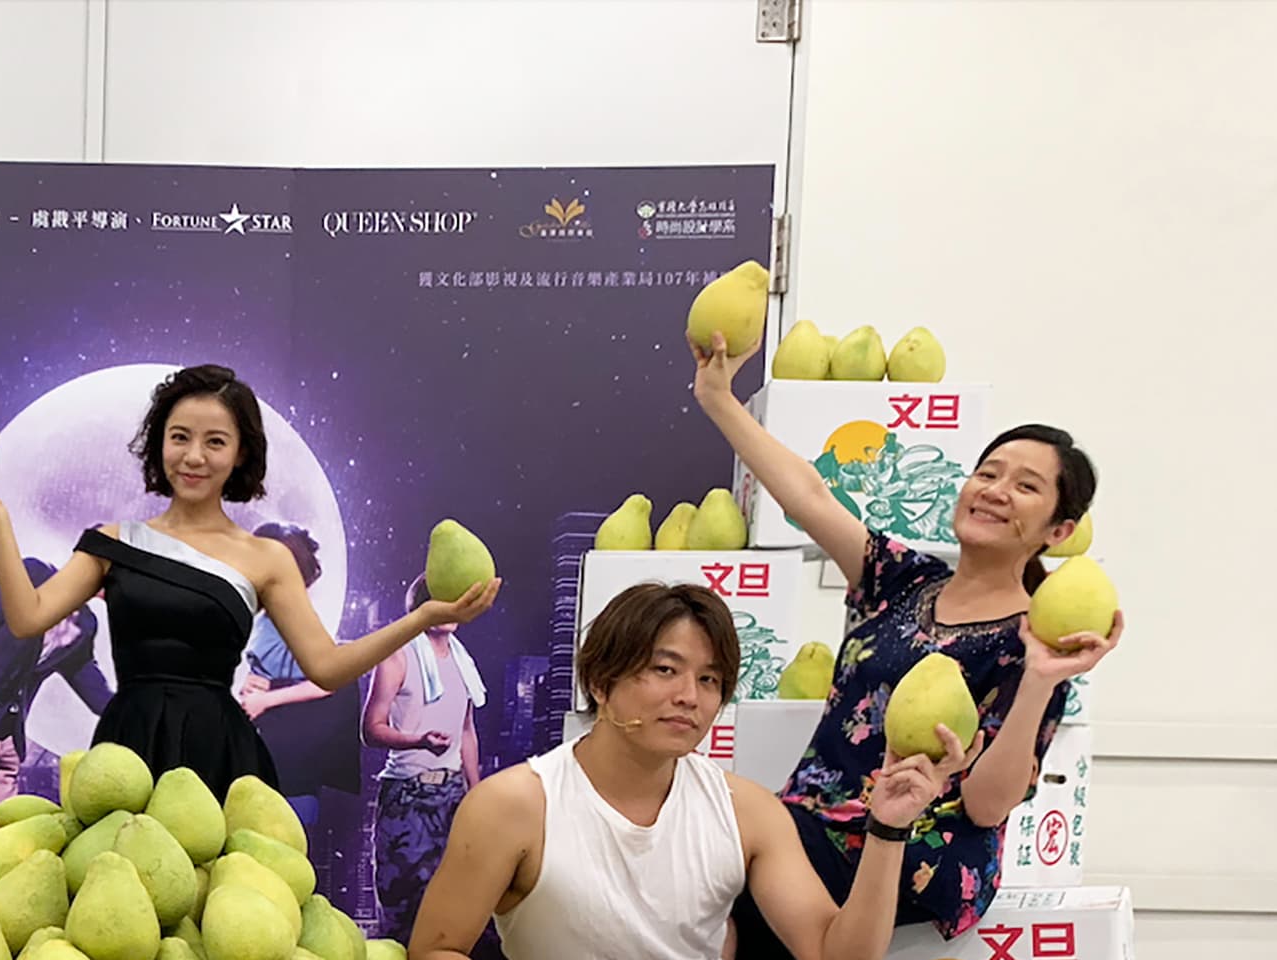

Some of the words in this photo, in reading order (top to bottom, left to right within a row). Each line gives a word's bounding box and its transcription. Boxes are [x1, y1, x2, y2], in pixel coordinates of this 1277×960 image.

[152, 212, 218, 229] FORTUNE
[252, 213, 293, 230] STAR
[887, 394, 960, 430] 文旦
[701, 562, 770, 597] 文旦
[692, 725, 735, 759] 旦
